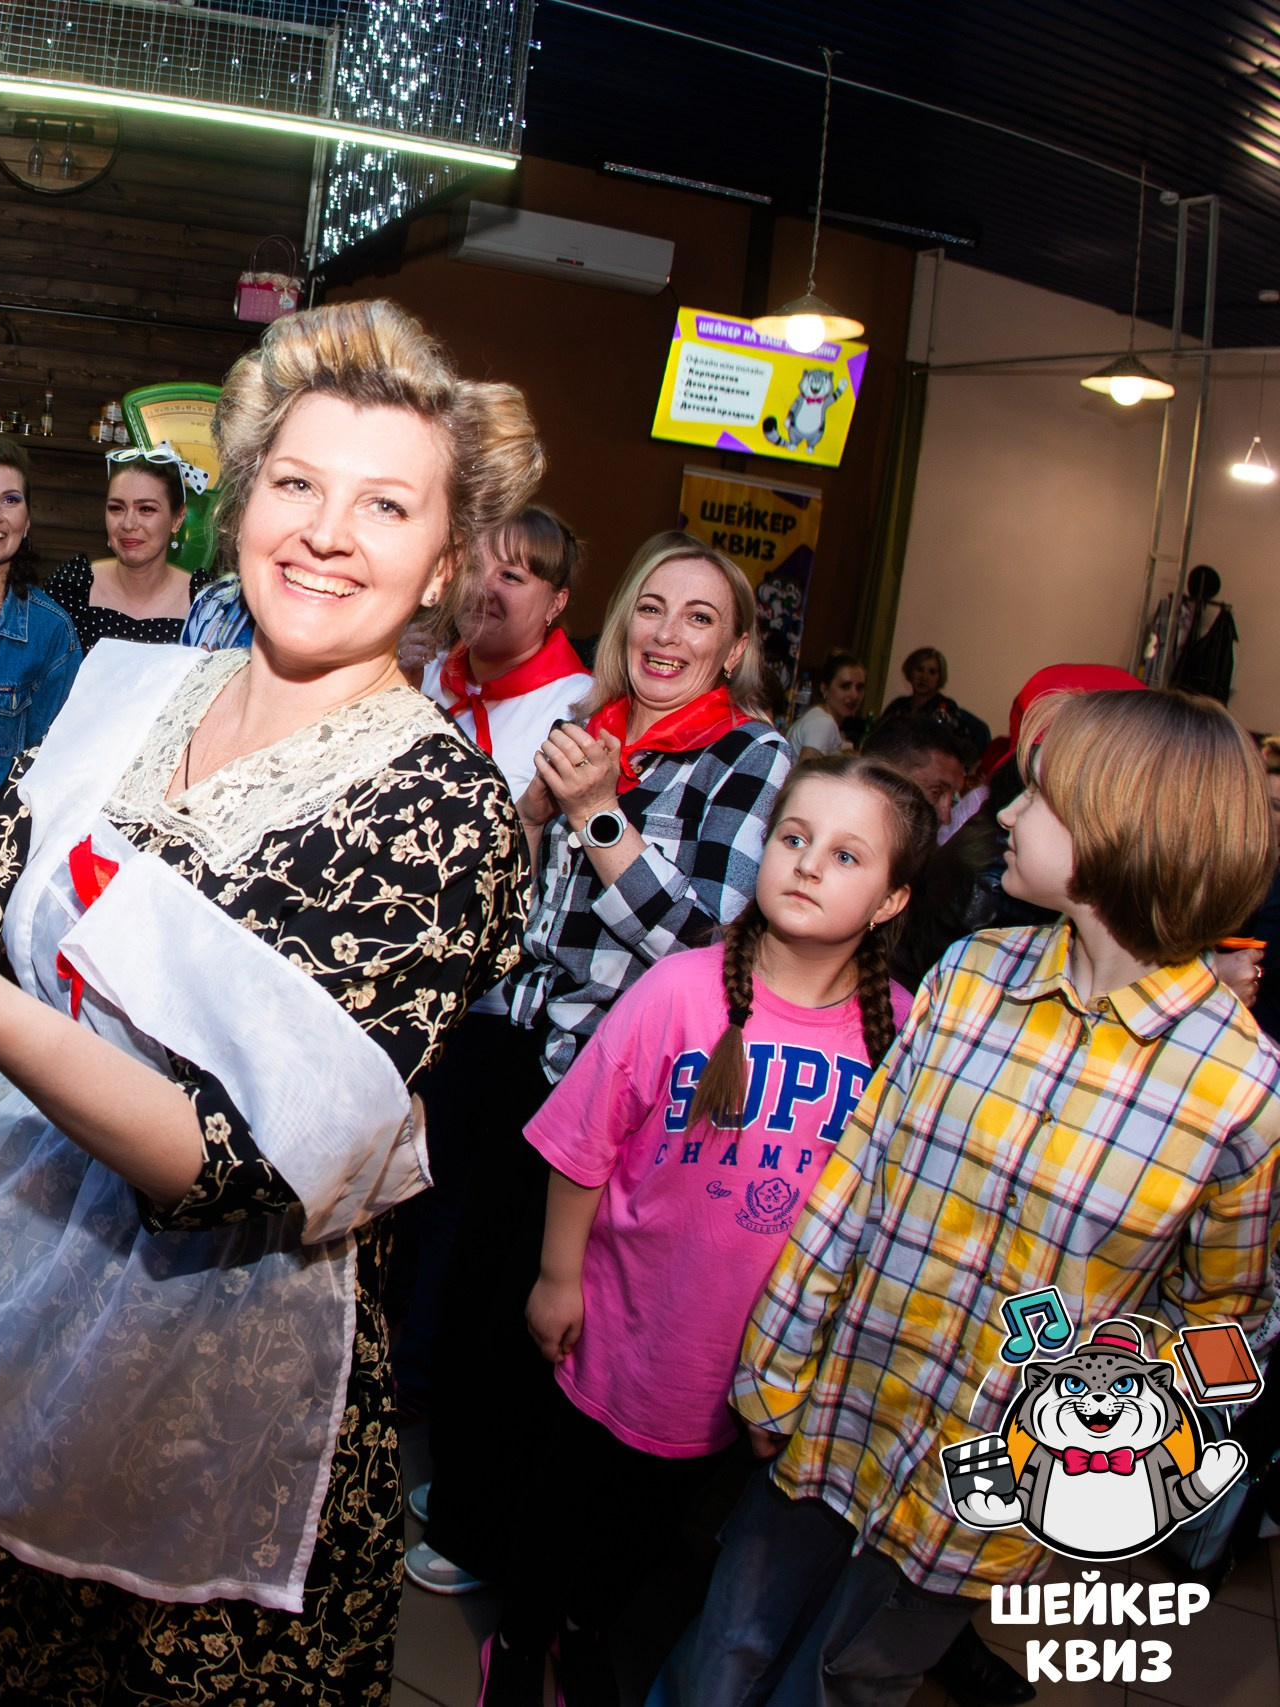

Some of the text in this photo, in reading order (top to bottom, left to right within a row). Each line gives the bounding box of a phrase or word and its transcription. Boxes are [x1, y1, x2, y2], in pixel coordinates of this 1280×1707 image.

[699, 320, 741, 339] ШЕЙКЕР
[743, 329, 757, 344] НА
[688, 367, 739, 383] Корпоратив
[683, 389, 718, 403] Свадьба
[685, 378, 750, 397] День рождения
[680, 400, 755, 420] Детский праздник
[700, 501, 797, 536] ШЕЙКЕР
[711, 531, 777, 561] КВИЗ
[740, 1218, 786, 1233] COLLEGE
